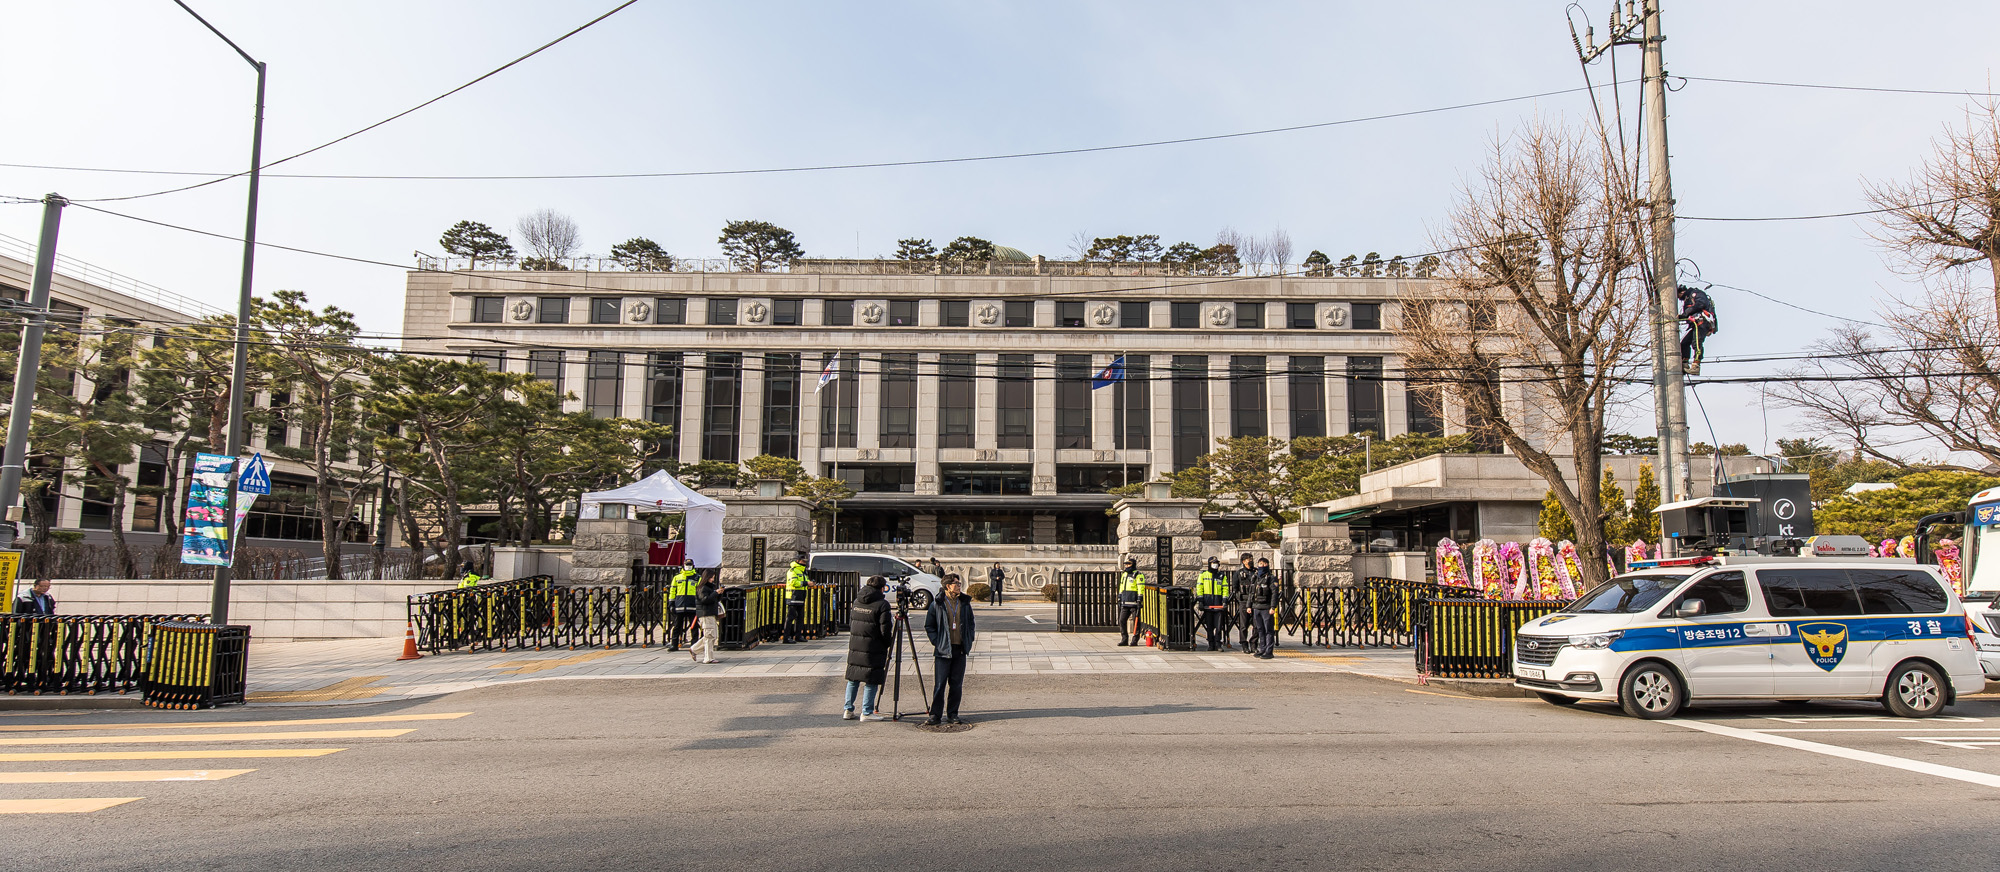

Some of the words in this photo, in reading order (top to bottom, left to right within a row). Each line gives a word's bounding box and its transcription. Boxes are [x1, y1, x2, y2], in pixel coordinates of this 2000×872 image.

[1779, 524, 1794, 536] kt
[1160, 537, 1170, 585] 헌법재판소
[1684, 628, 1741, 641] 방송조명12
[1907, 620, 1942, 636] 경찰
